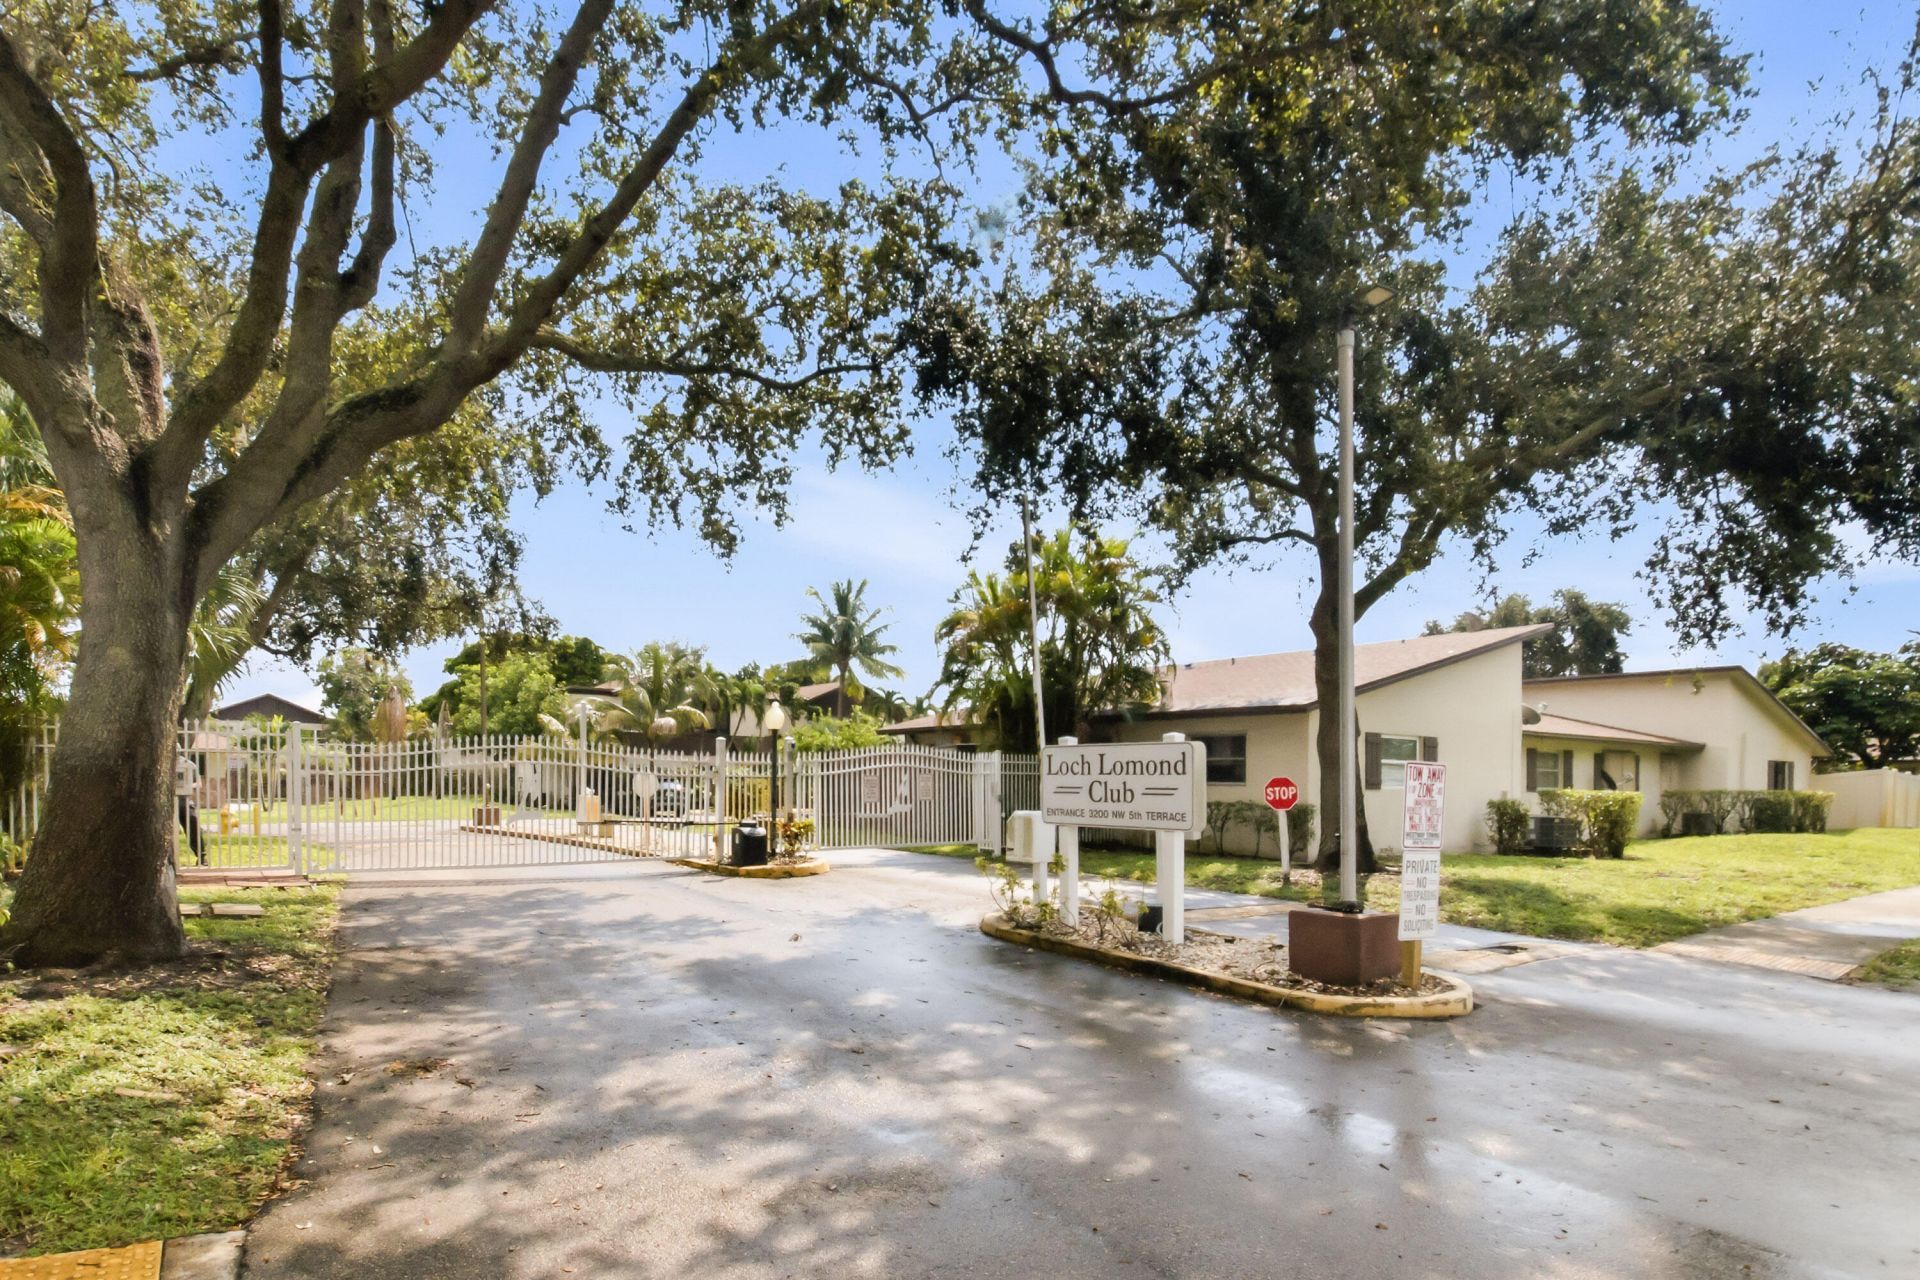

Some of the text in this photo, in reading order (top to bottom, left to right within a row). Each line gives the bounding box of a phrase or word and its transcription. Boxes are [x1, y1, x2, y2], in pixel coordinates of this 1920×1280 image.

[1046, 751, 1187, 776] Loch Lomond
[1409, 766, 1444, 782] TOW AWAY
[1088, 780, 1135, 803] Club
[1266, 786, 1297, 801] STOP
[1417, 782, 1435, 798] ZONE
[1046, 807, 1188, 823] ENTRANCE 3200 NW 5th TERRACE
[1405, 860, 1438, 874] PRIVATE
[1416, 876, 1428, 889] NO
[1415, 904, 1427, 916] NO
